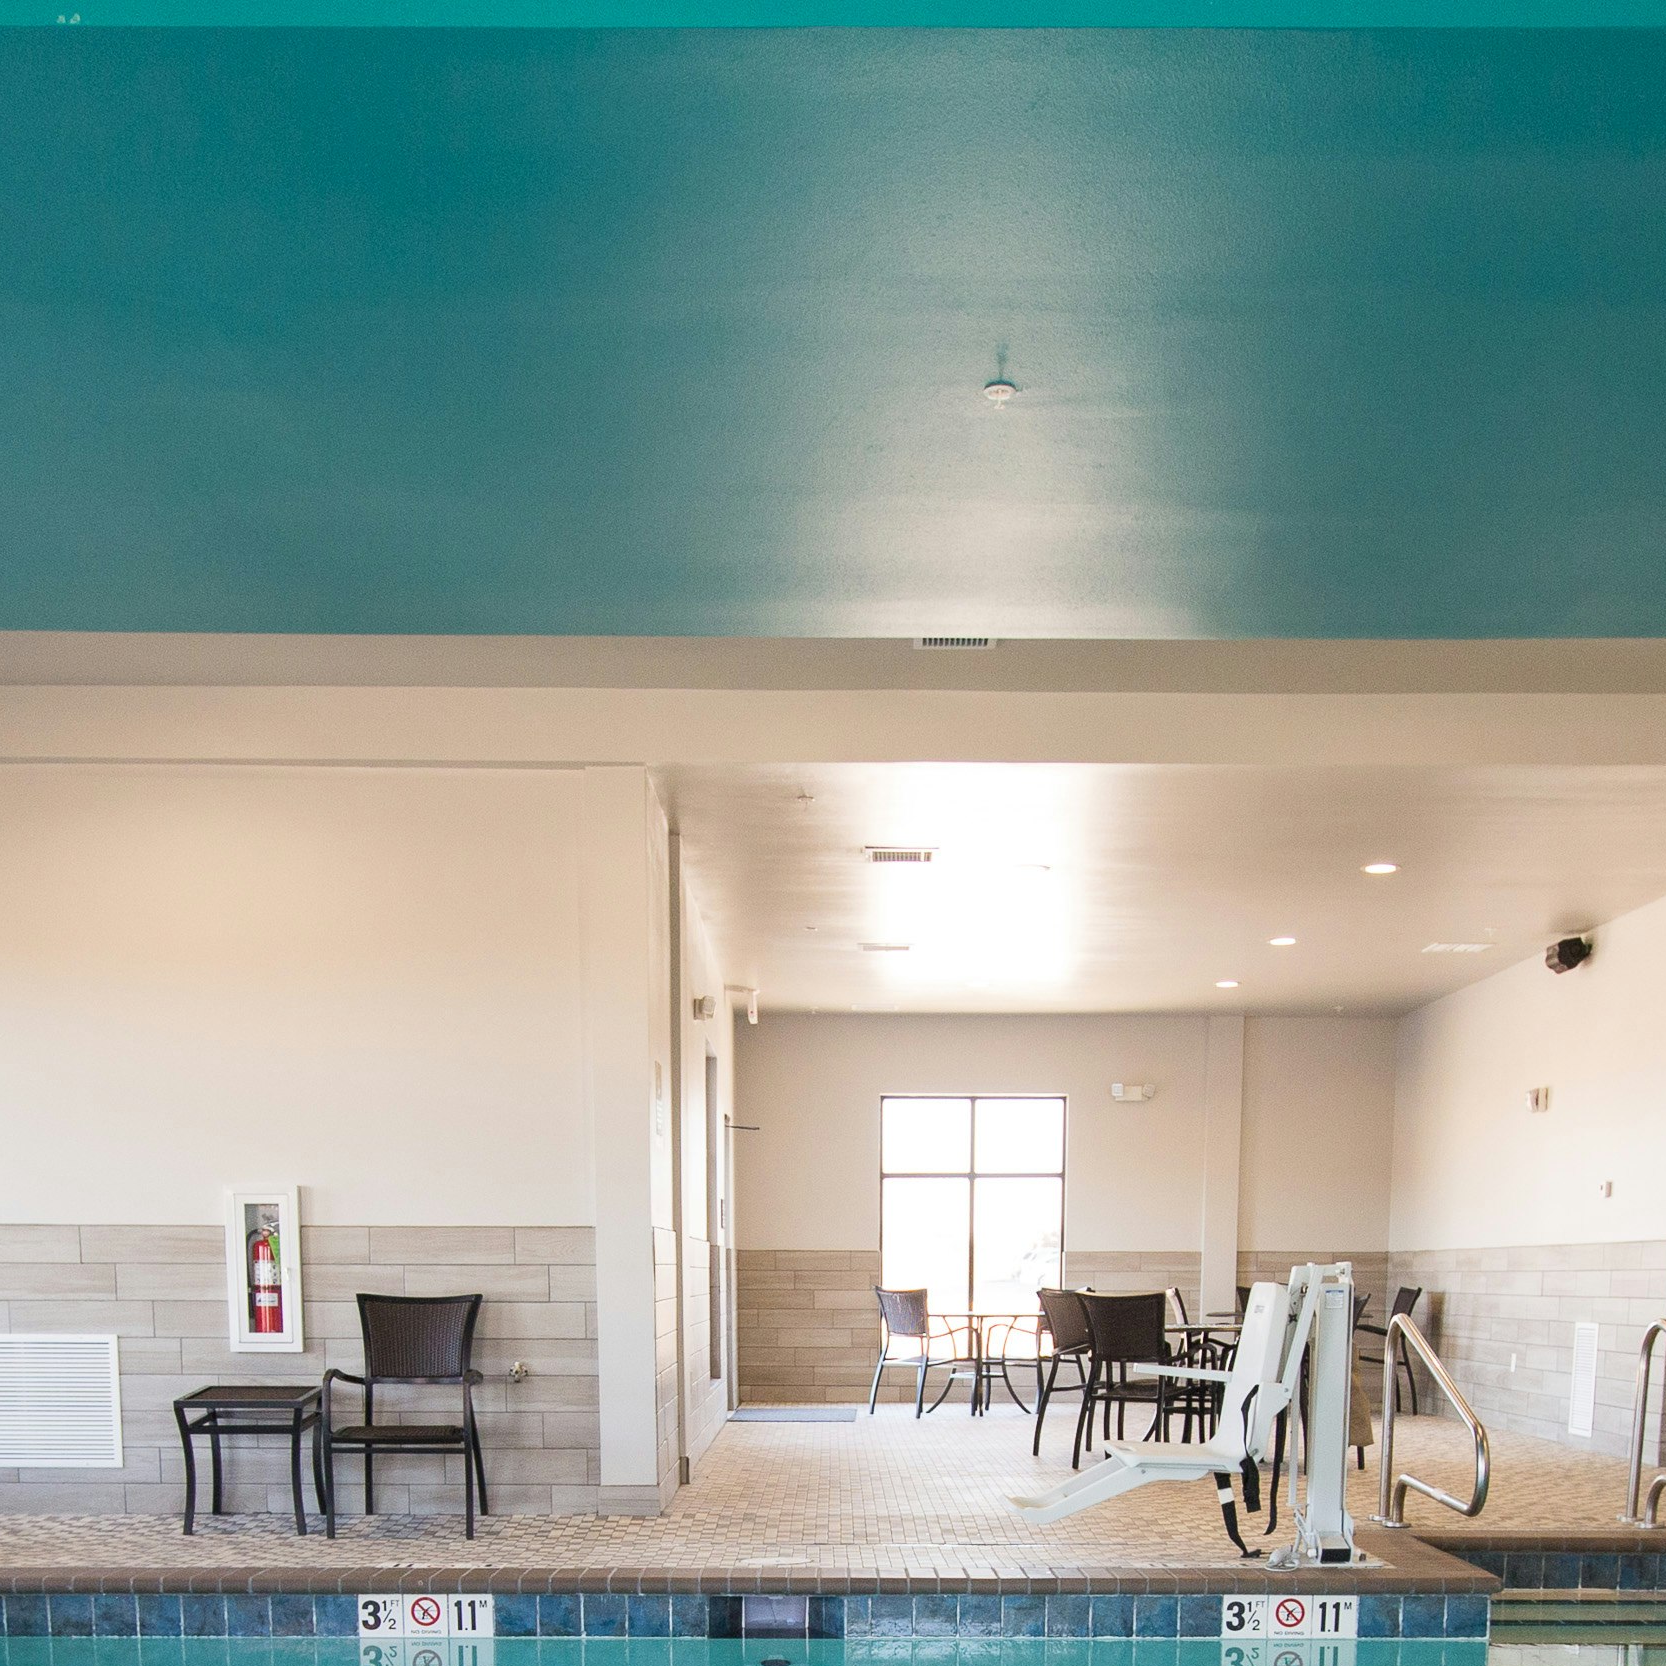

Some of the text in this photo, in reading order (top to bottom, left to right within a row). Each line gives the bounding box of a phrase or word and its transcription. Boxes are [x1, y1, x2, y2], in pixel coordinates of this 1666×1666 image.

[390, 1599, 400, 1608] FT
[479, 1600, 488, 1608] M
[1255, 1600, 1266, 1609] FT
[1343, 1602, 1353, 1610] M
